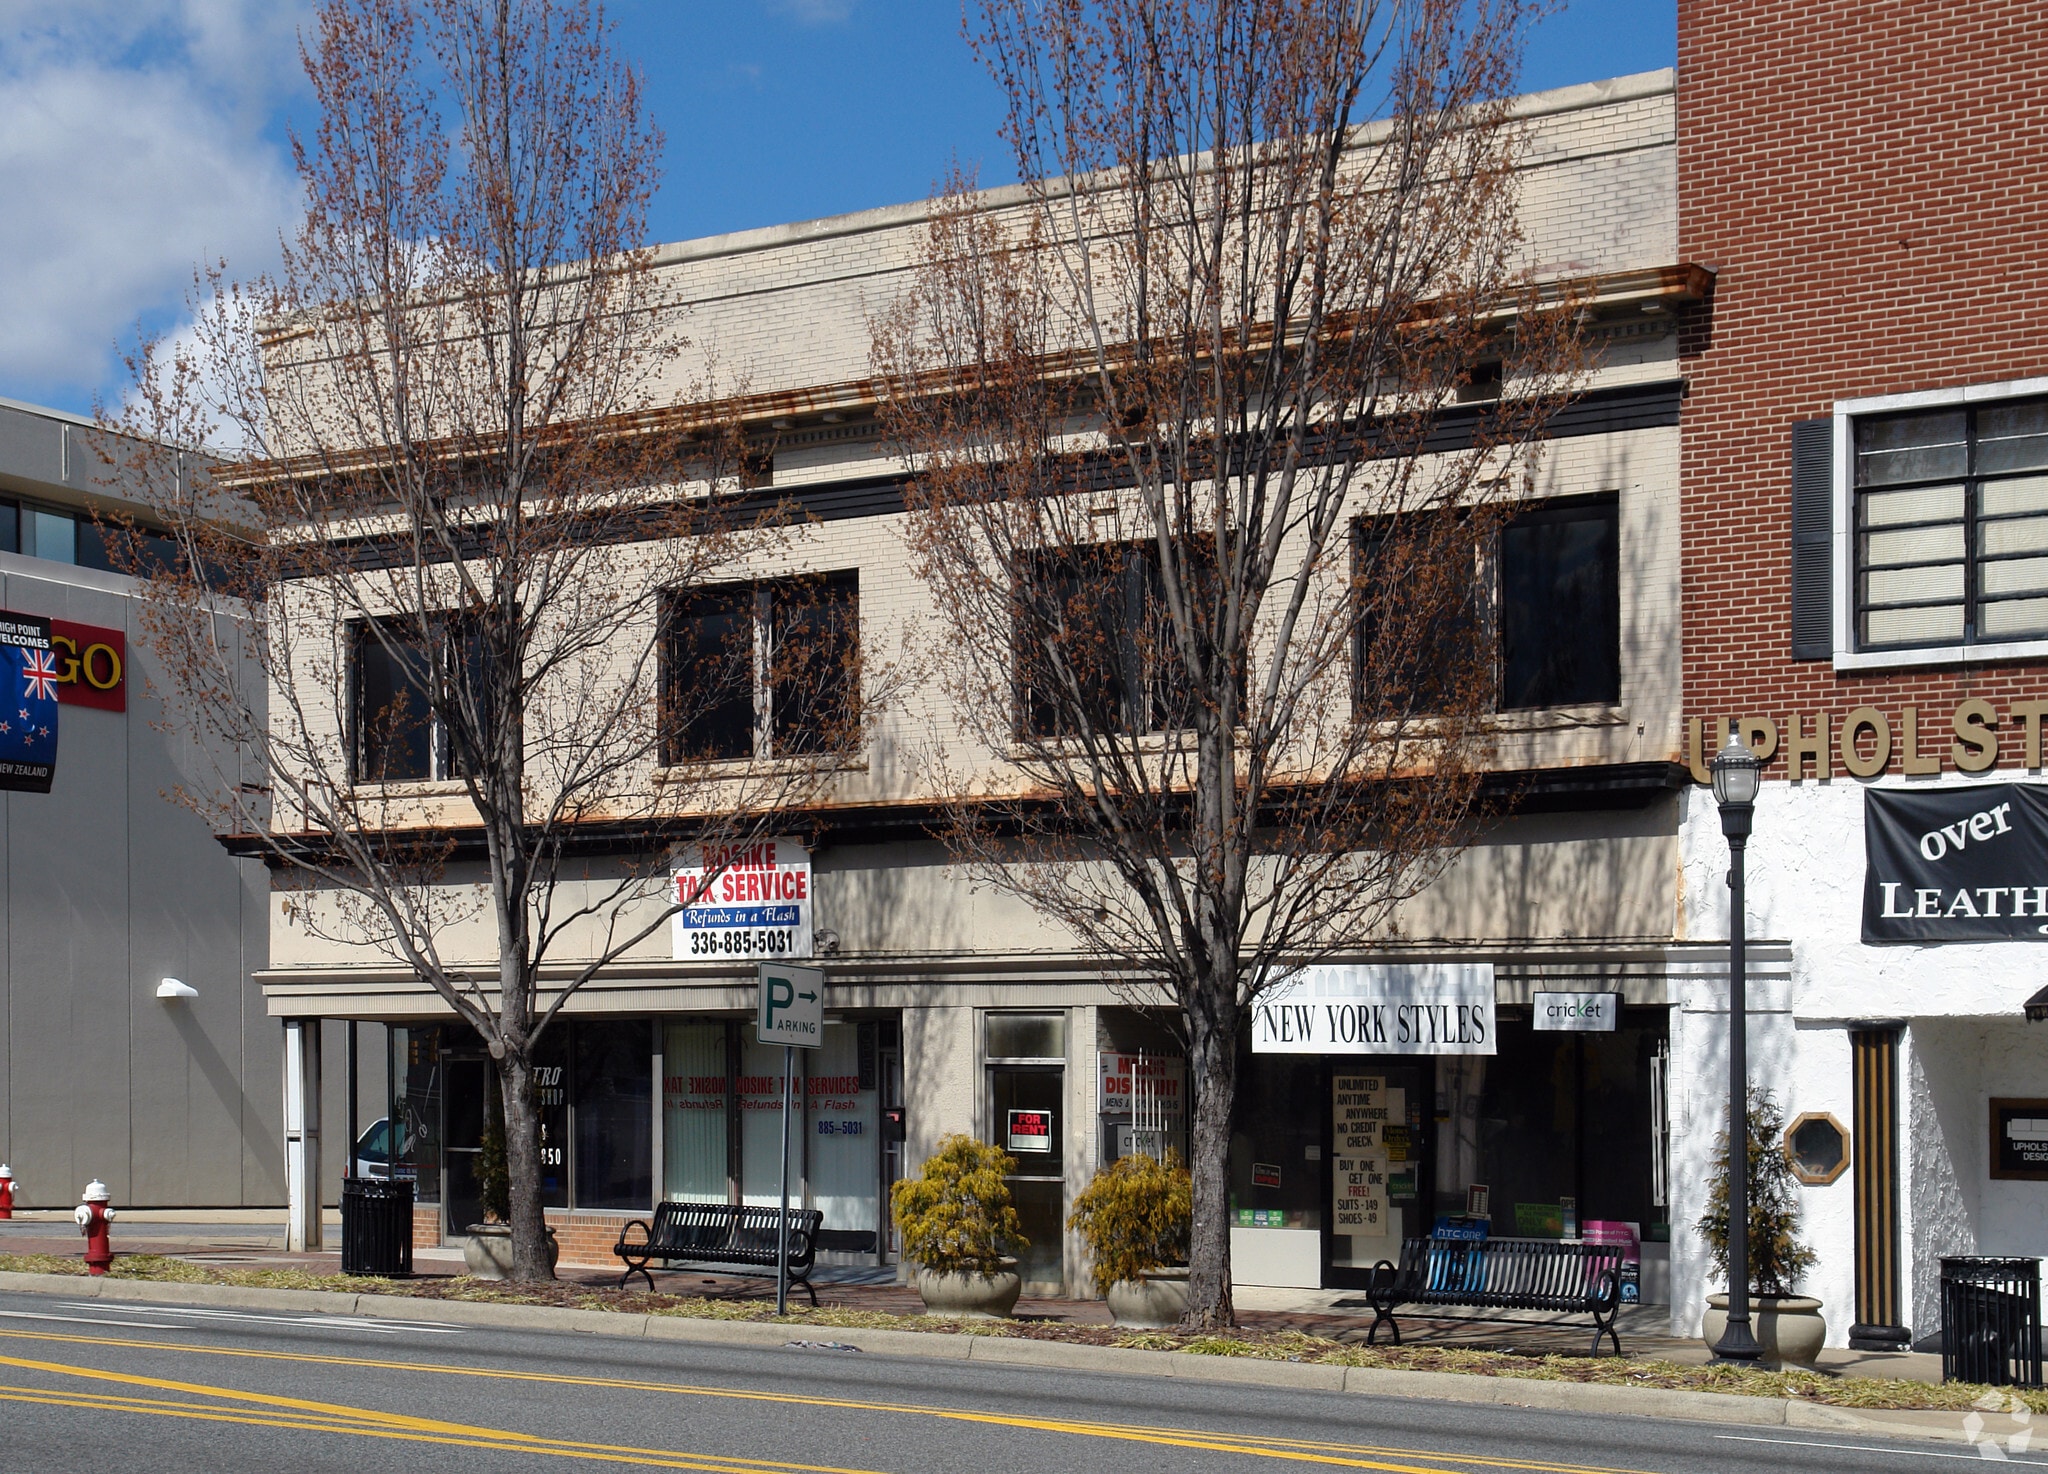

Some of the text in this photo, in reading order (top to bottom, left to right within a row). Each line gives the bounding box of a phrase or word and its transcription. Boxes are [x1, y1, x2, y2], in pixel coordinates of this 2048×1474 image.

[17, 624, 41, 637] POINT
[0, 633, 49, 649] ELCOMES
[14, 764, 48, 777] ZEALAND
[1920, 802, 2012, 861] over
[676, 871, 807, 904] TAX SERVICE
[1879, 882, 2048, 918] LEATH
[685, 906, 795, 928] Refunds in a Flash
[691, 929, 793, 954] 336-885-5031
[1546, 998, 1602, 1018] cricket
[1263, 1004, 1485, 1044] NEW YORK STYLES
[735, 1076, 860, 1095] NOSIKE TX SERVICES
[1338, 1079, 1379, 1091] UNLIMITED
[541, 1088, 564, 1106] SHOP
[1337, 1094, 1371, 1106] ANYTIME
[740, 1099, 783, 1110] Refunds
[810, 1100, 818, 1110] A
[824, 1100, 856, 1110] Flash
[1018, 1113, 1041, 1125] FOR
[1346, 1108, 1389, 1120] ANYWHERE
[1012, 1123, 1048, 1136] RENT
[1337, 1121, 1377, 1134] NO CREDIT
[1346, 1135, 1374, 1148] CHECK
[1340, 1159, 1376, 1172] BUY ONE
[1349, 1173, 1383, 1184] GET ONE
[1348, 1185, 1370, 1197] FREE!
[1337, 1199, 1359, 1211] SUITS
[1365, 1199, 1378, 1211] 149
[1338, 1212, 1363, 1224] SHOES
[1368, 1212, 1378, 1224] 49
